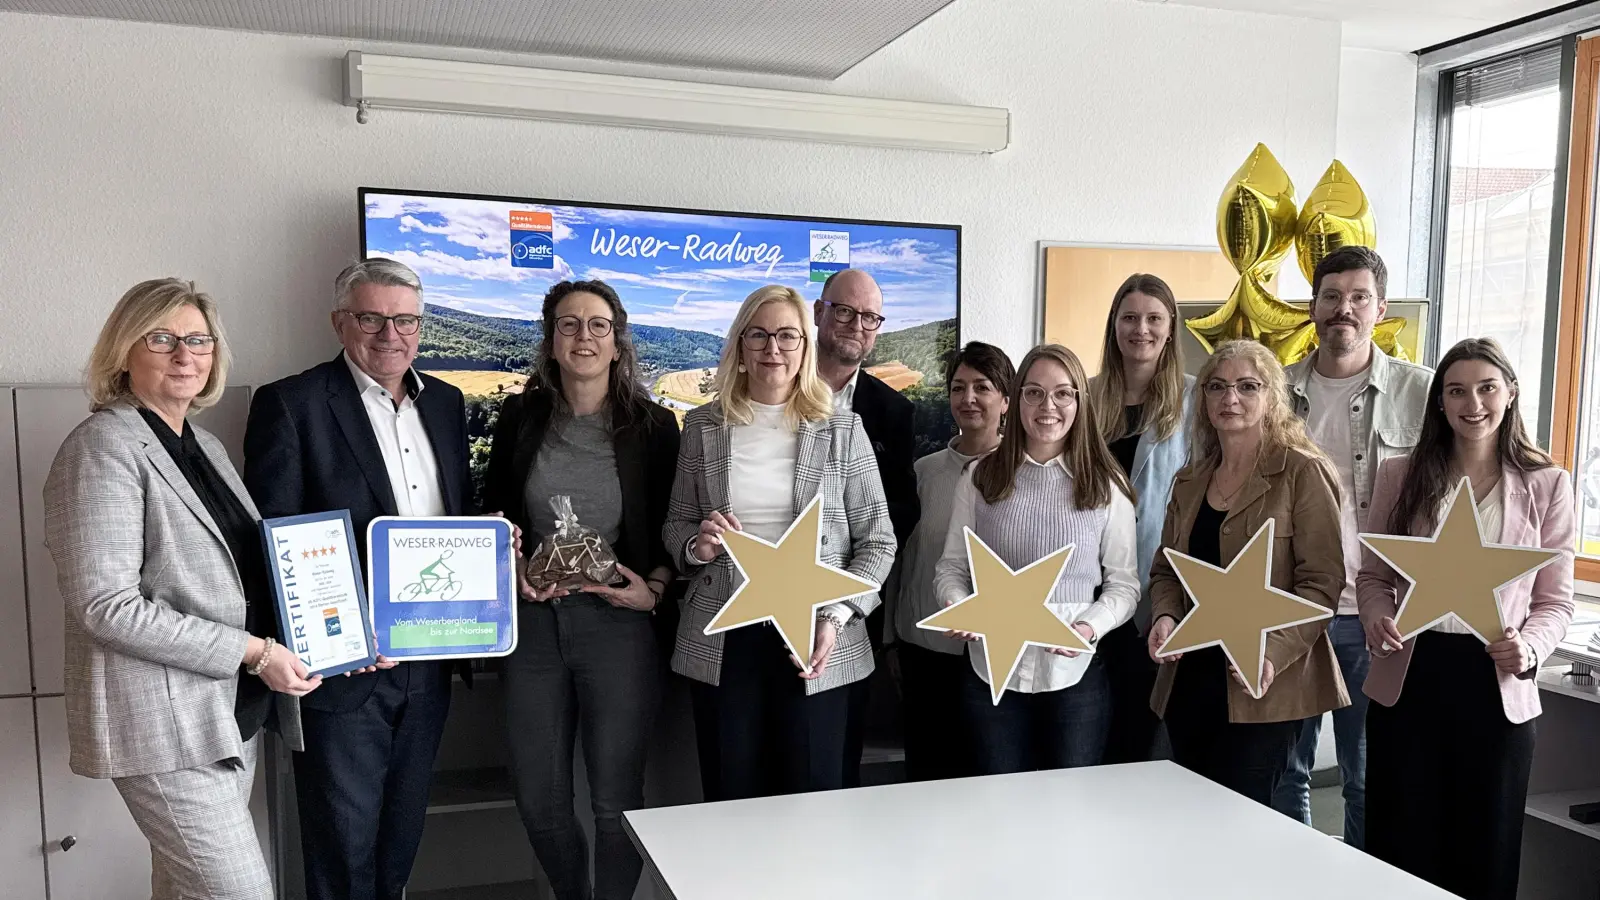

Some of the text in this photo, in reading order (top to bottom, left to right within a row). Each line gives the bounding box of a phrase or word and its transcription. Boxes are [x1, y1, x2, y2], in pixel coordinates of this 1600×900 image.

[528, 245, 553, 254] adfc
[590, 228, 784, 278] Weser-Radweg
[276, 537, 312, 667] ZERTIFIKAT
[394, 616, 477, 627] Vom Weserbergland
[430, 628, 442, 636] bis
[460, 626, 494, 635] Nordsee
